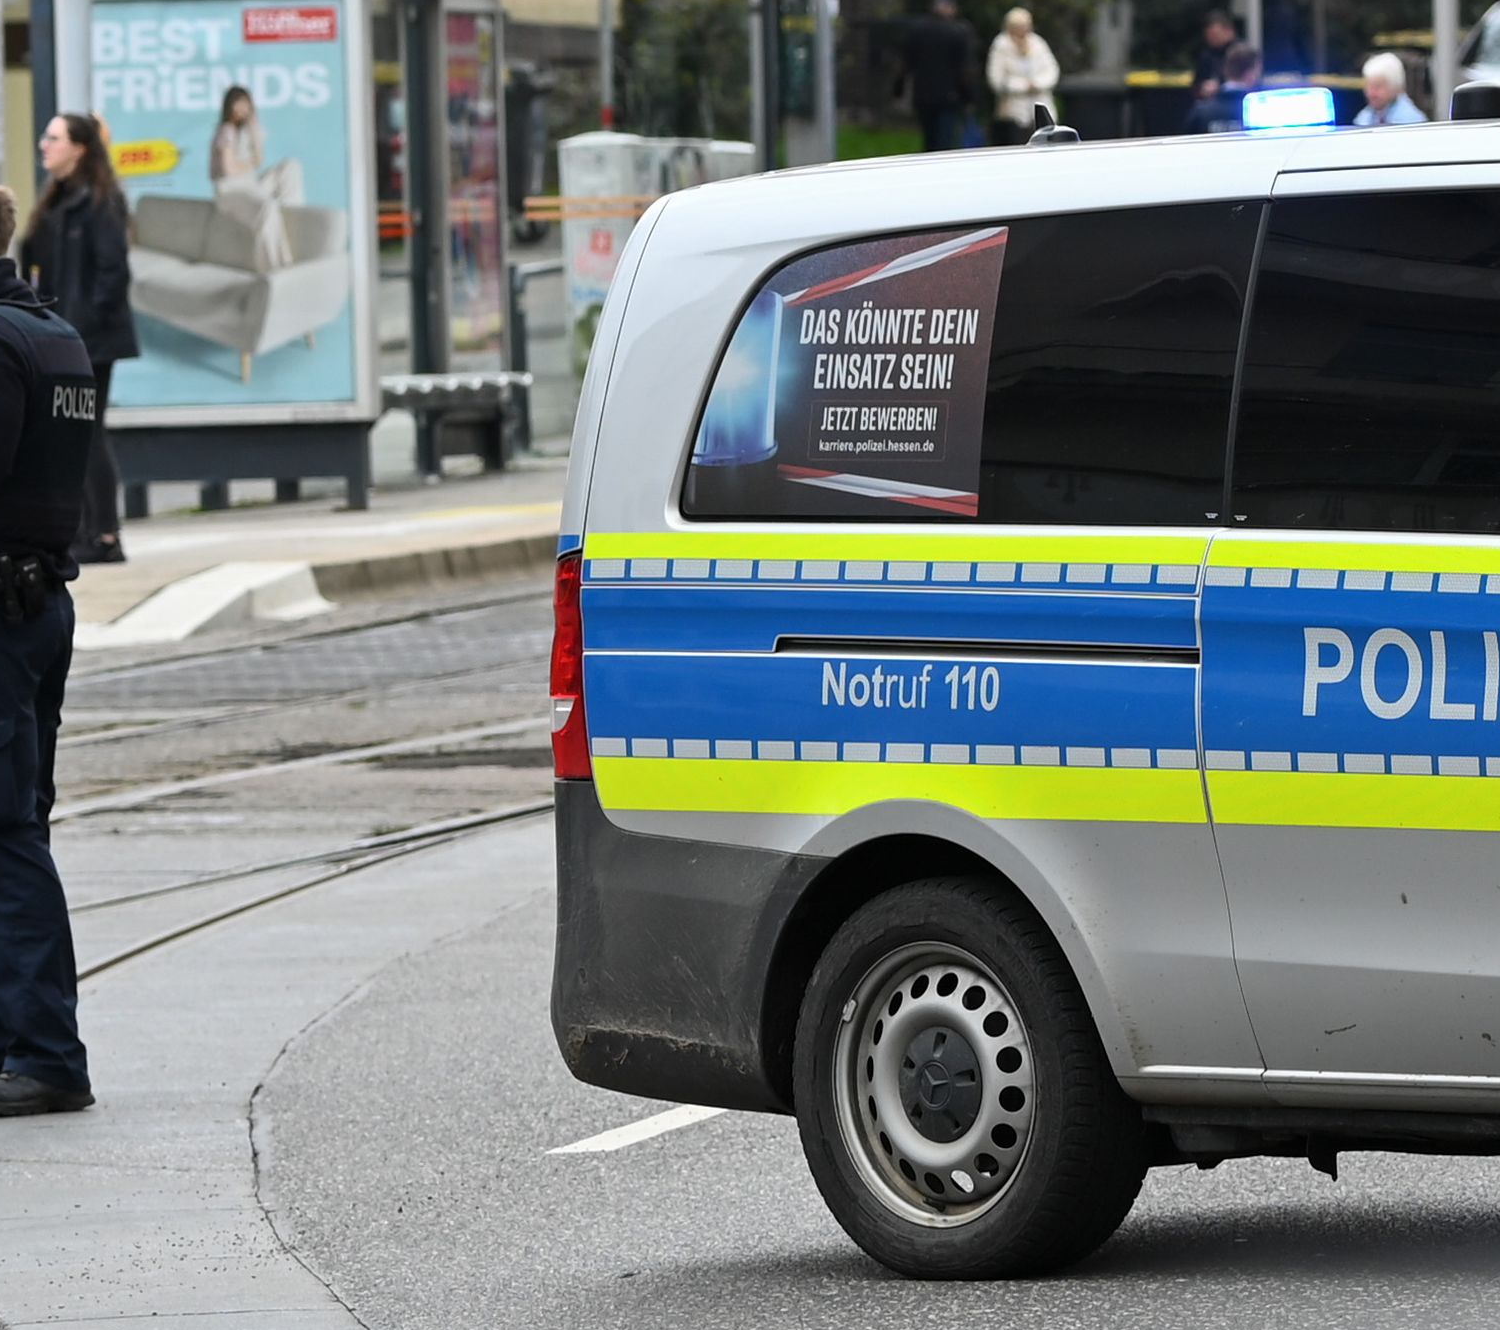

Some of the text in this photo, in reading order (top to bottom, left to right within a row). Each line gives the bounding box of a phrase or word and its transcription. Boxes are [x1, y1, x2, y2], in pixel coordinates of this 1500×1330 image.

[92, 18, 230, 64] BEST
[799, 300, 979, 345] DAS KÖNNTE DEIN
[813, 353, 954, 390] EINSATZ SEIN!
[820, 407, 938, 431] JETZT BEWERBEN!
[818, 439, 935, 455] karriere.polizei.hessen.de
[821, 660, 1001, 712] Notruf 110
